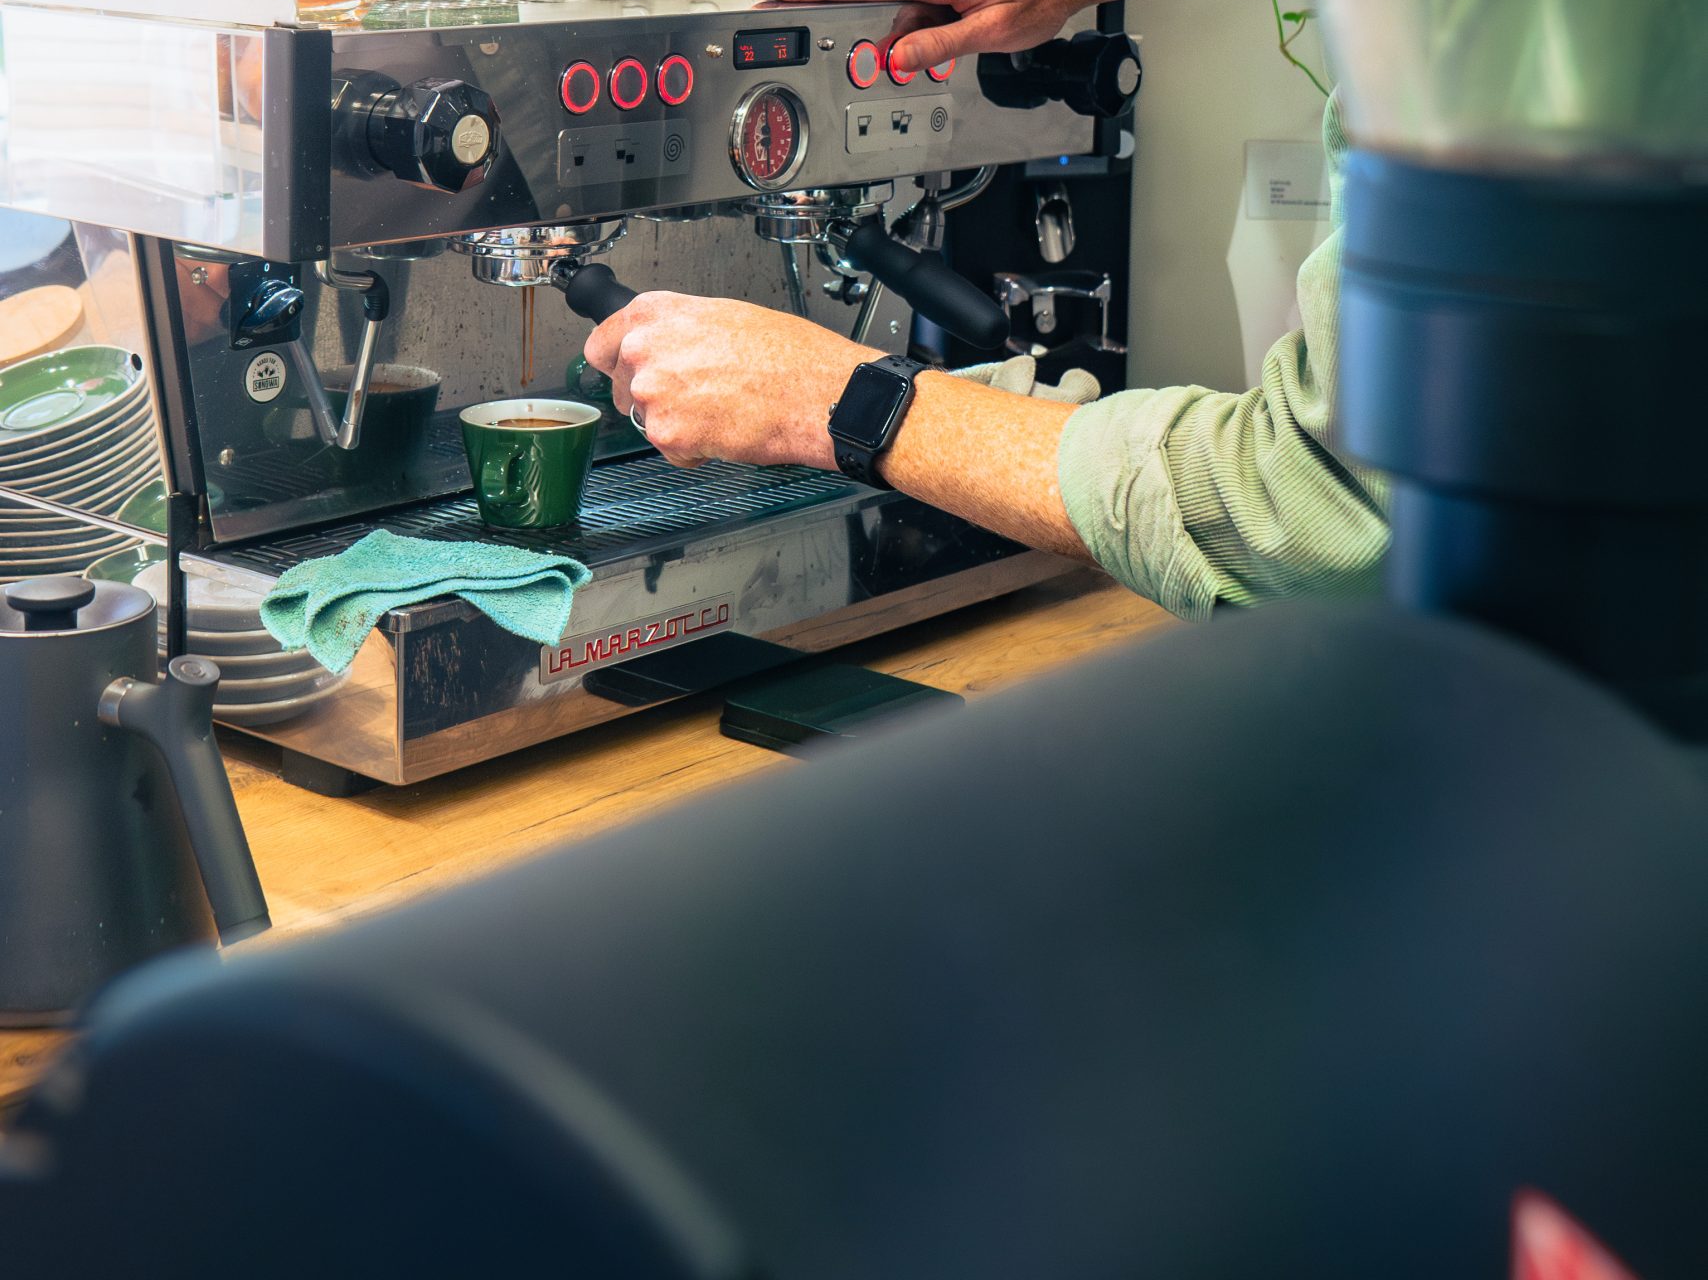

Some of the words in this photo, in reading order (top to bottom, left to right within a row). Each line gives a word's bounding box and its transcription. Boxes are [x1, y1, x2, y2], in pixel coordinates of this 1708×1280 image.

[263, 263, 270, 272] 0
[289, 275, 294, 284] 1
[549, 648, 576, 674] LA
[584, 603, 730, 664] MARZOCCO
